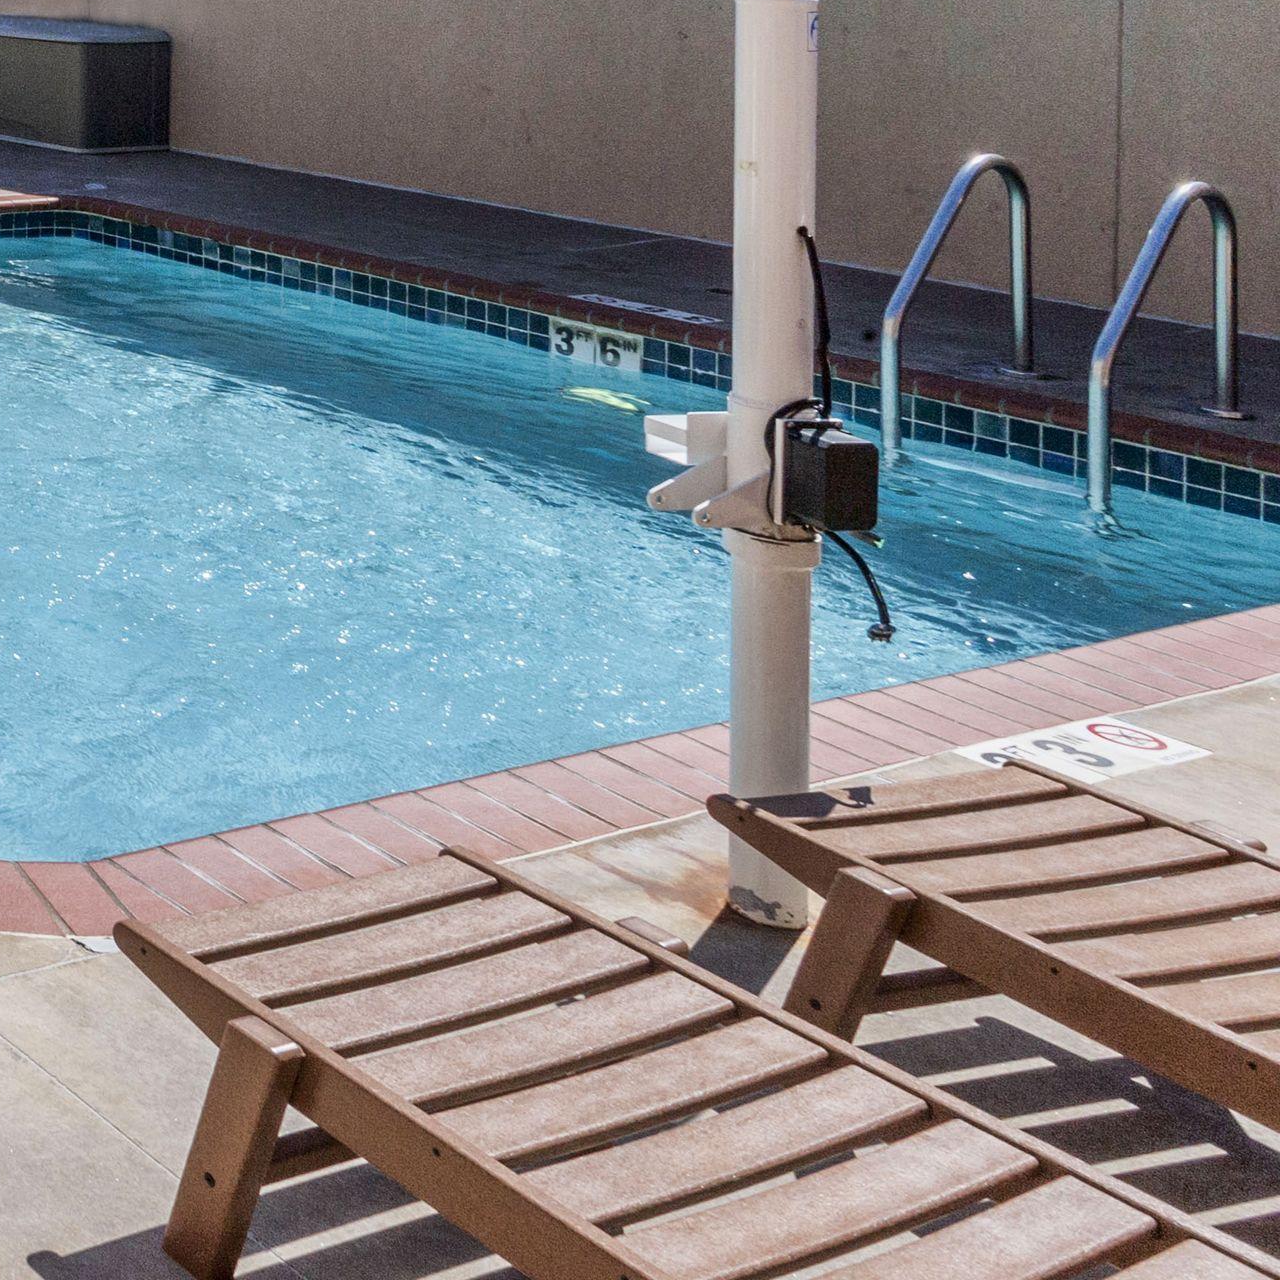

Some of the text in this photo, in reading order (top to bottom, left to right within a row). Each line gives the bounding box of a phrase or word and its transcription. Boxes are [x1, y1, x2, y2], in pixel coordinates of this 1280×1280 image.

[554, 326, 638, 367] 3 FT 6 IN
[1052, 733, 1090, 746] IN
[1001, 745, 1037, 758] FT
[1032, 740, 1114, 767] 3
